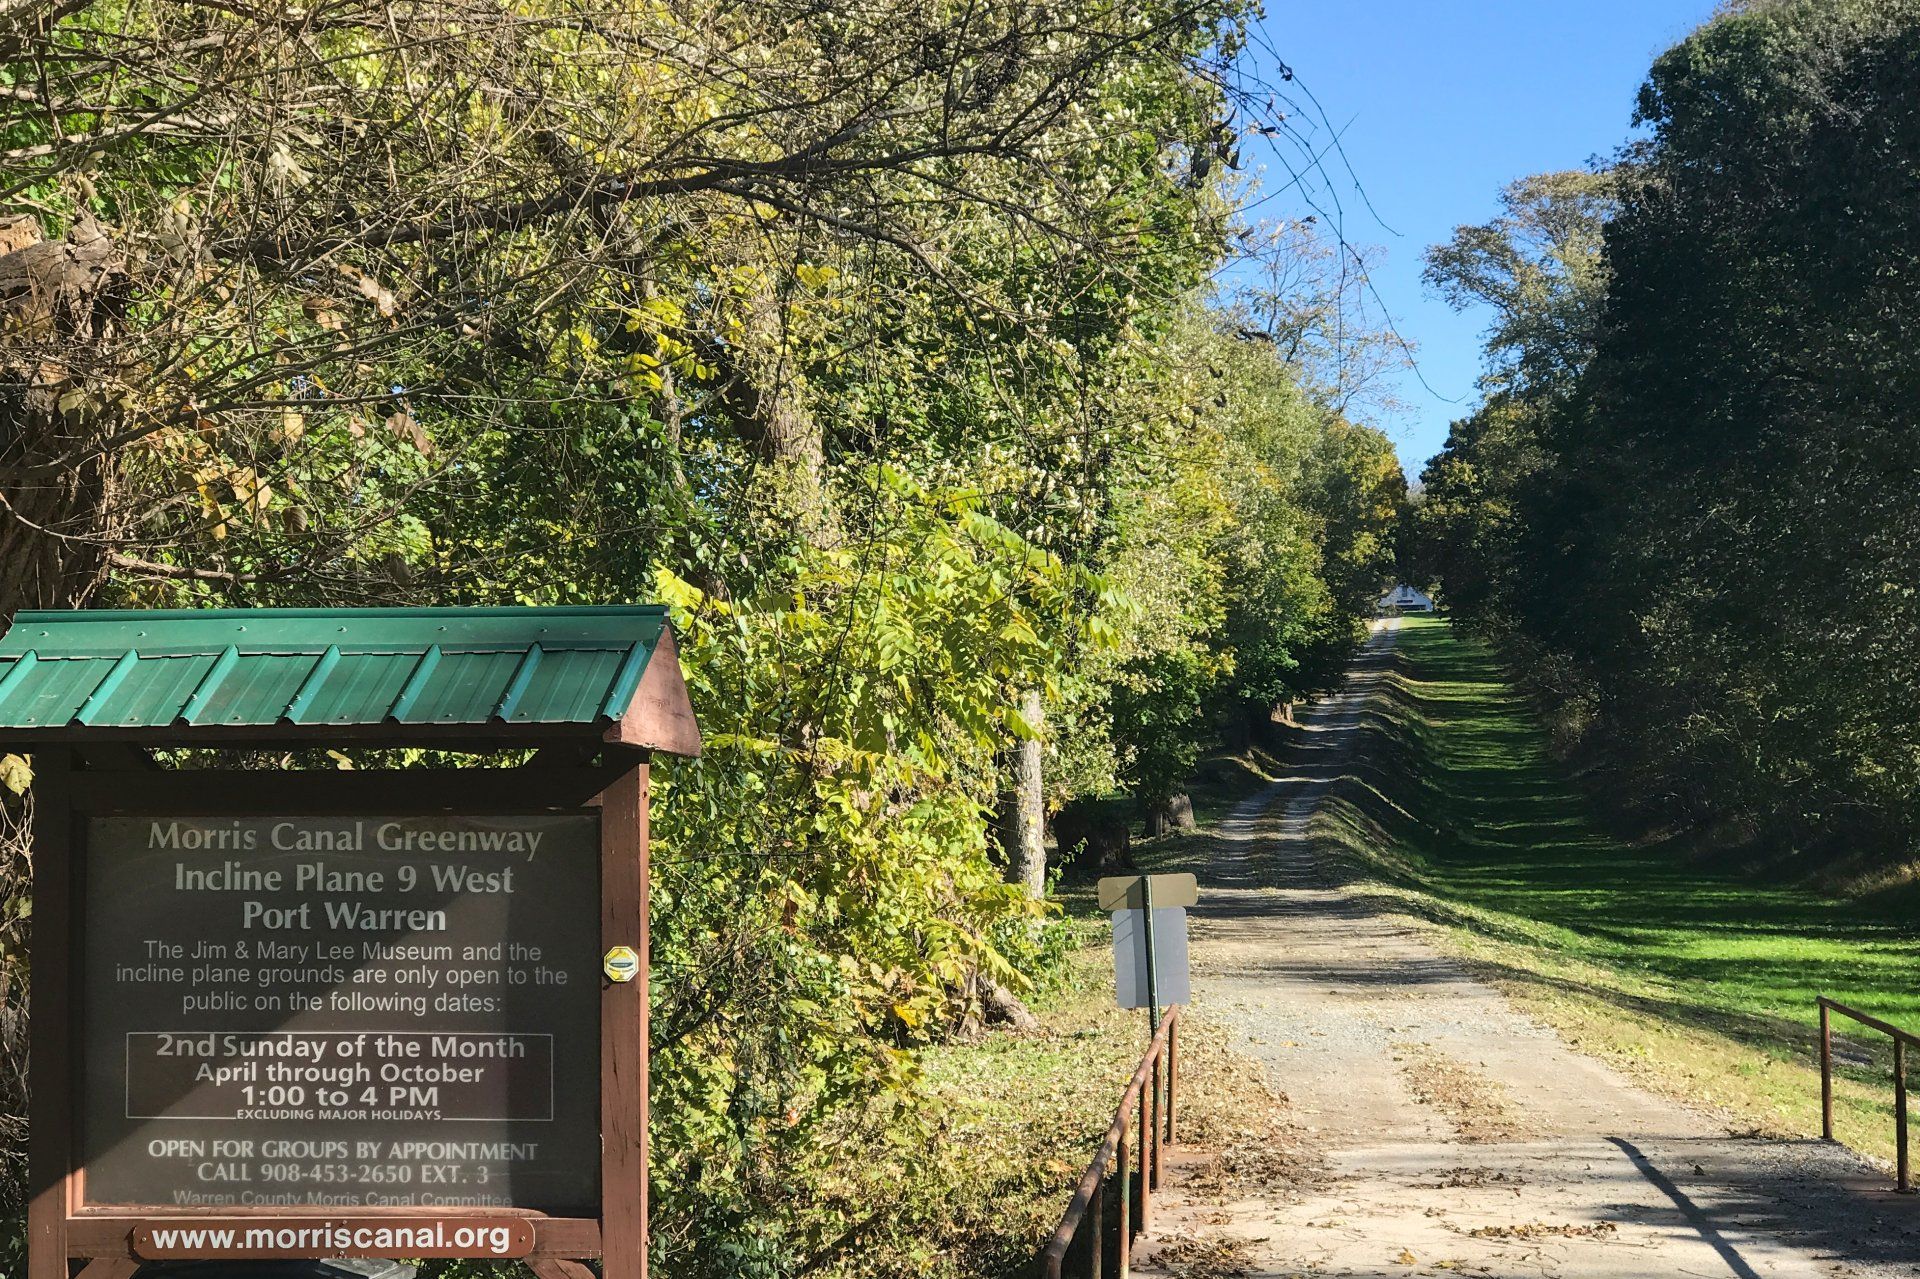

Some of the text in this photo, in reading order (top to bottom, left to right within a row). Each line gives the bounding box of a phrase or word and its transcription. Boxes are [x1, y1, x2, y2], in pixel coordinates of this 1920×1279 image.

[148, 820, 544, 862] Morris Canal Greenway
[175, 861, 515, 894] Incline Plane 9 West
[243, 901, 447, 931] Port Warren
[144, 940, 542, 964] The Jim & Mary Lee Museum and the
[116, 963, 568, 989] incline plane grounds are only open to the
[183, 991, 501, 1017] public on the following dates:
[156, 1034, 525, 1063] 2nd Sunday of the Month
[195, 1062, 484, 1088] April through October
[241, 1086, 438, 1107] 1:00 to 4 PM
[236, 1109, 441, 1121] EXCLUDING MAJOR HOLIDAYS
[148, 1140, 539, 1161] OPEN FOR GROUPS BY APPOINTMENT
[197, 1163, 488, 1184] CALL 908-453-2650 EXT. 3
[173, 1190, 513, 1208] Warren County Morris Canal Committee
[152, 1217, 510, 1254] www.morriscanal.org
